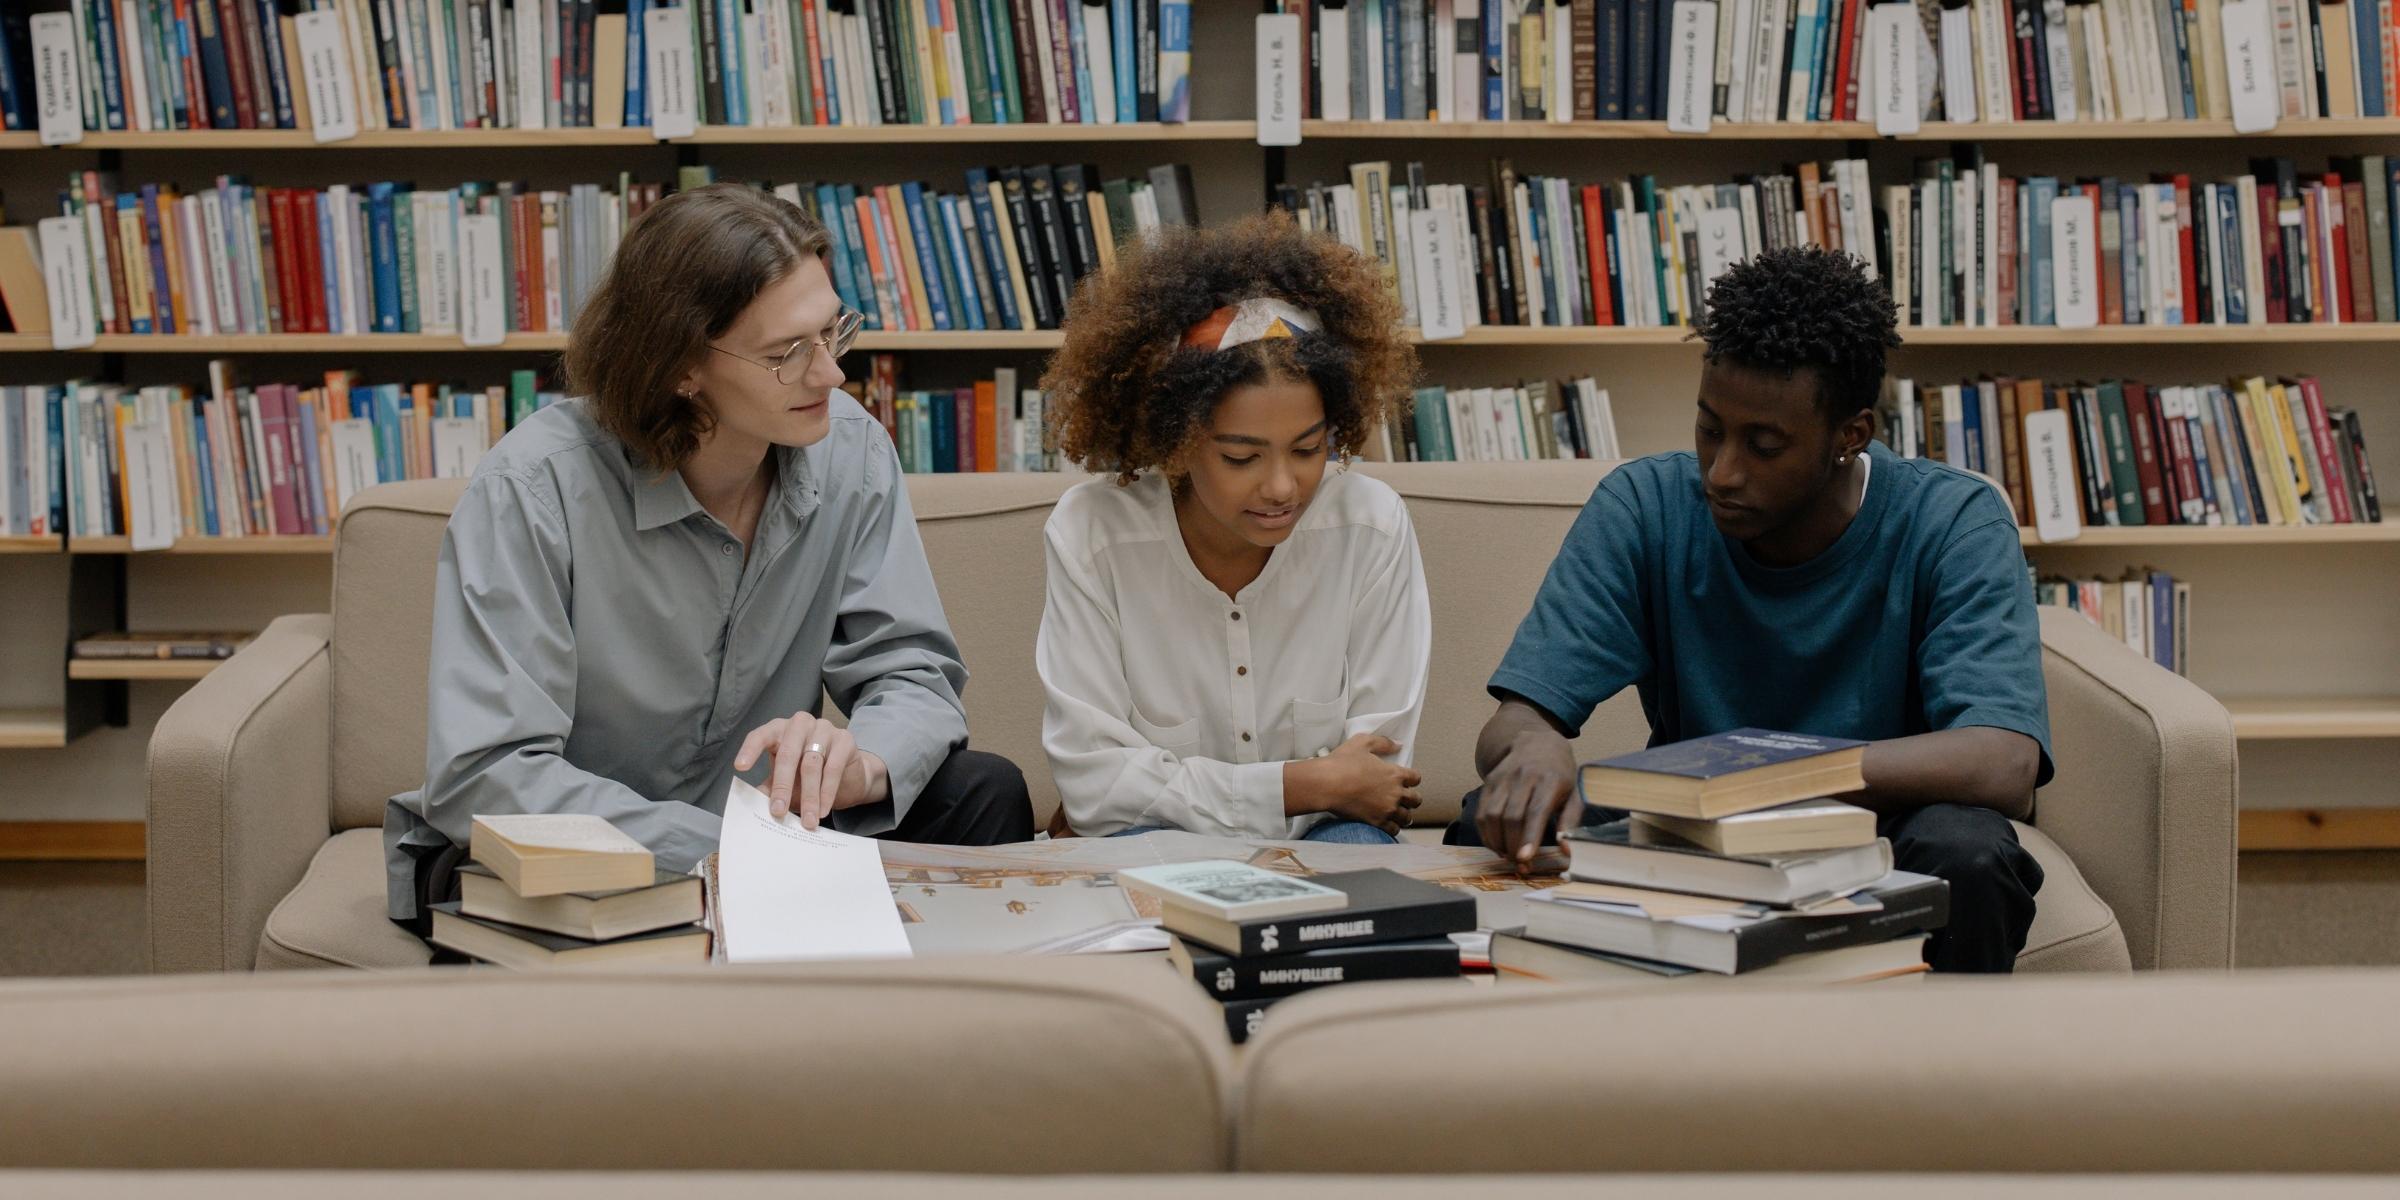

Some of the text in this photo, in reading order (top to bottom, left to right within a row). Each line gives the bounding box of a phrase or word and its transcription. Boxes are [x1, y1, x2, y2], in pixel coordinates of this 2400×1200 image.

[40, 46, 58, 118] Судебная
[1270, 35, 1285, 121] Гоголь Н. В.
[1679, 8, 1699, 127] Достоевский Ф. М.
[1888, 22, 1904, 113] Персоналии
[2240, 37, 2256, 93] Блок А.
[1713, 227, 1725, 240] С.
[1714, 242, 1727, 259] А.
[2066, 215, 2082, 307] Булгаков М.
[1426, 216, 1448, 328] Лермонтов М. Ю.
[2041, 428, 2063, 521] Высоцкий В.
[1260, 925, 1279, 951] 14
[1299, 920, 1374, 941] МИНУВШЕЕ
[1216, 967, 1236, 991] 15
[1259, 967, 1344, 985] МИНУВШЕЕ
